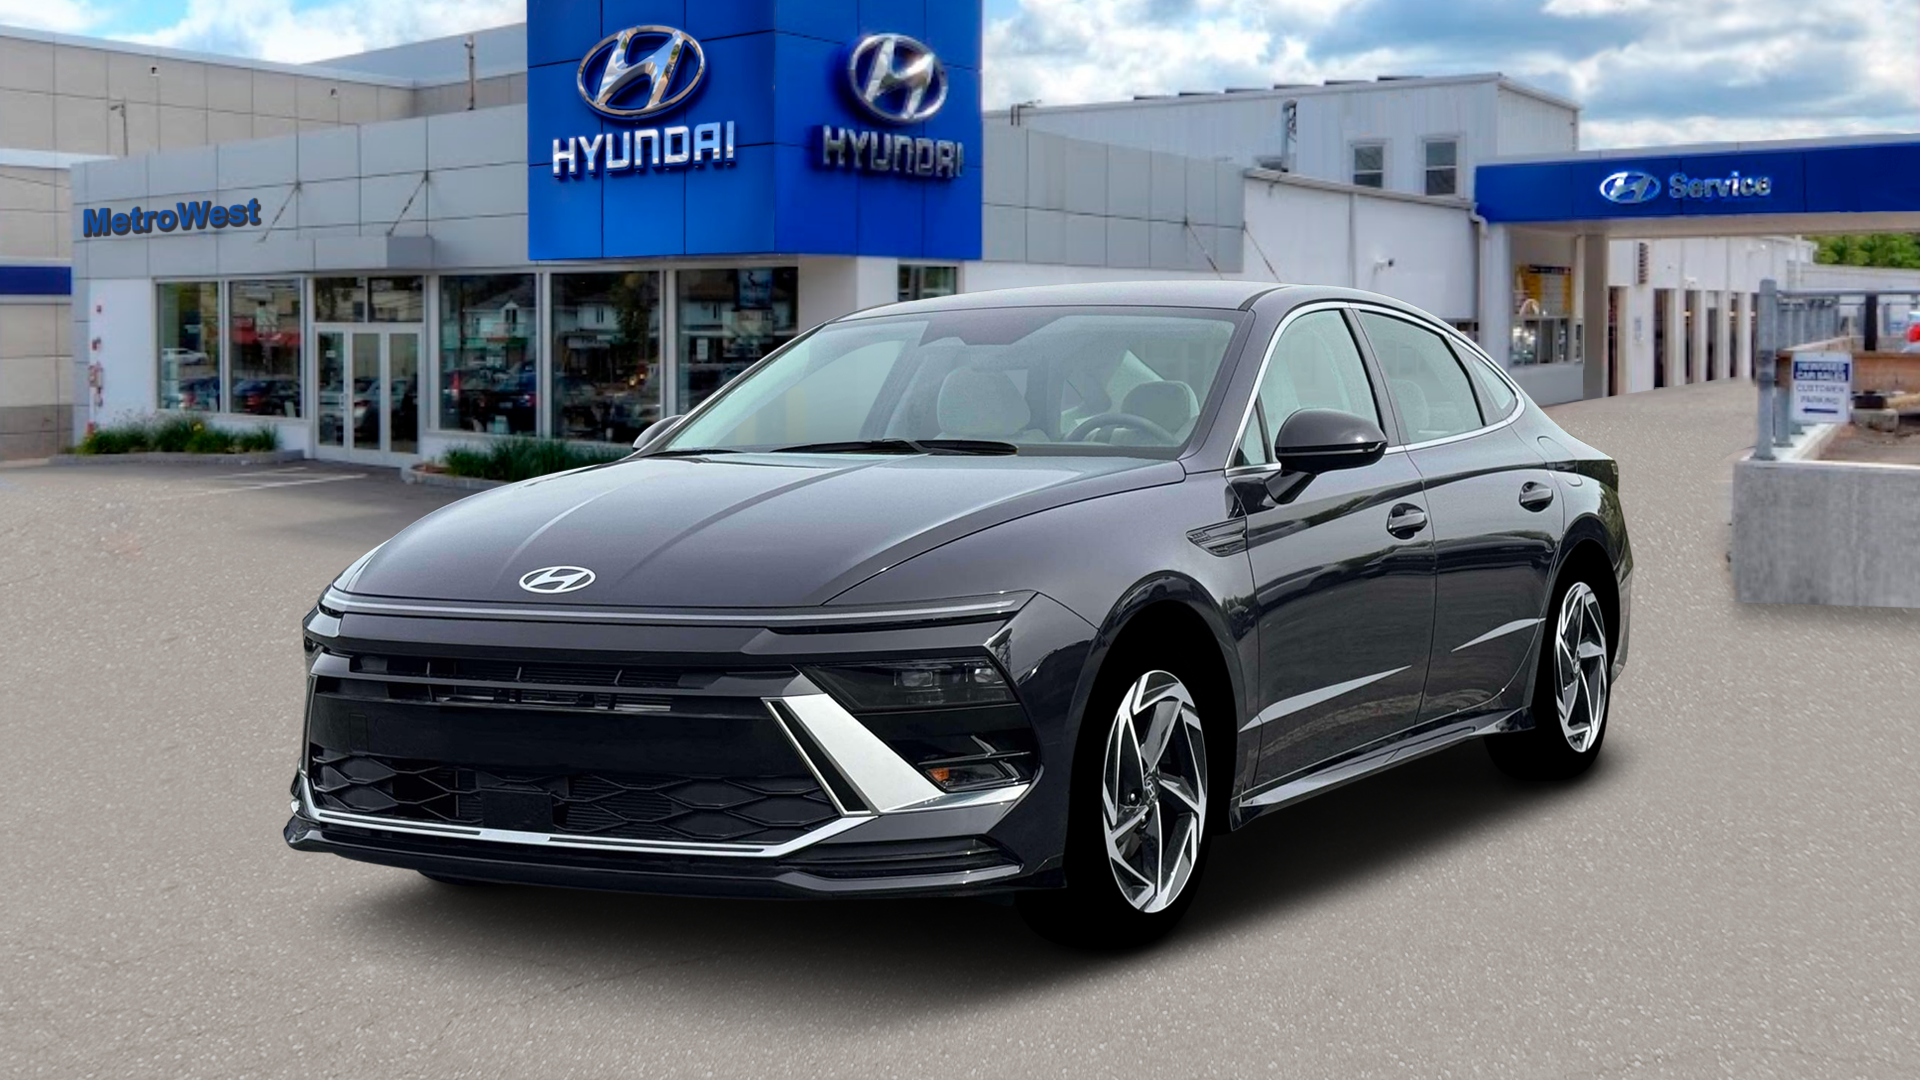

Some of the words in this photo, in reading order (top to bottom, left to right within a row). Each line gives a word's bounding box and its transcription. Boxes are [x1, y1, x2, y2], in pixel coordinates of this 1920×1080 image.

[553, 121, 735, 176] HYUNDAI
[822, 125, 964, 178] HYUNDAI
[1669, 170, 1772, 198] Service
[83, 197, 262, 238] MetroWest
[1796, 384, 1844, 393] CUSTOMER
